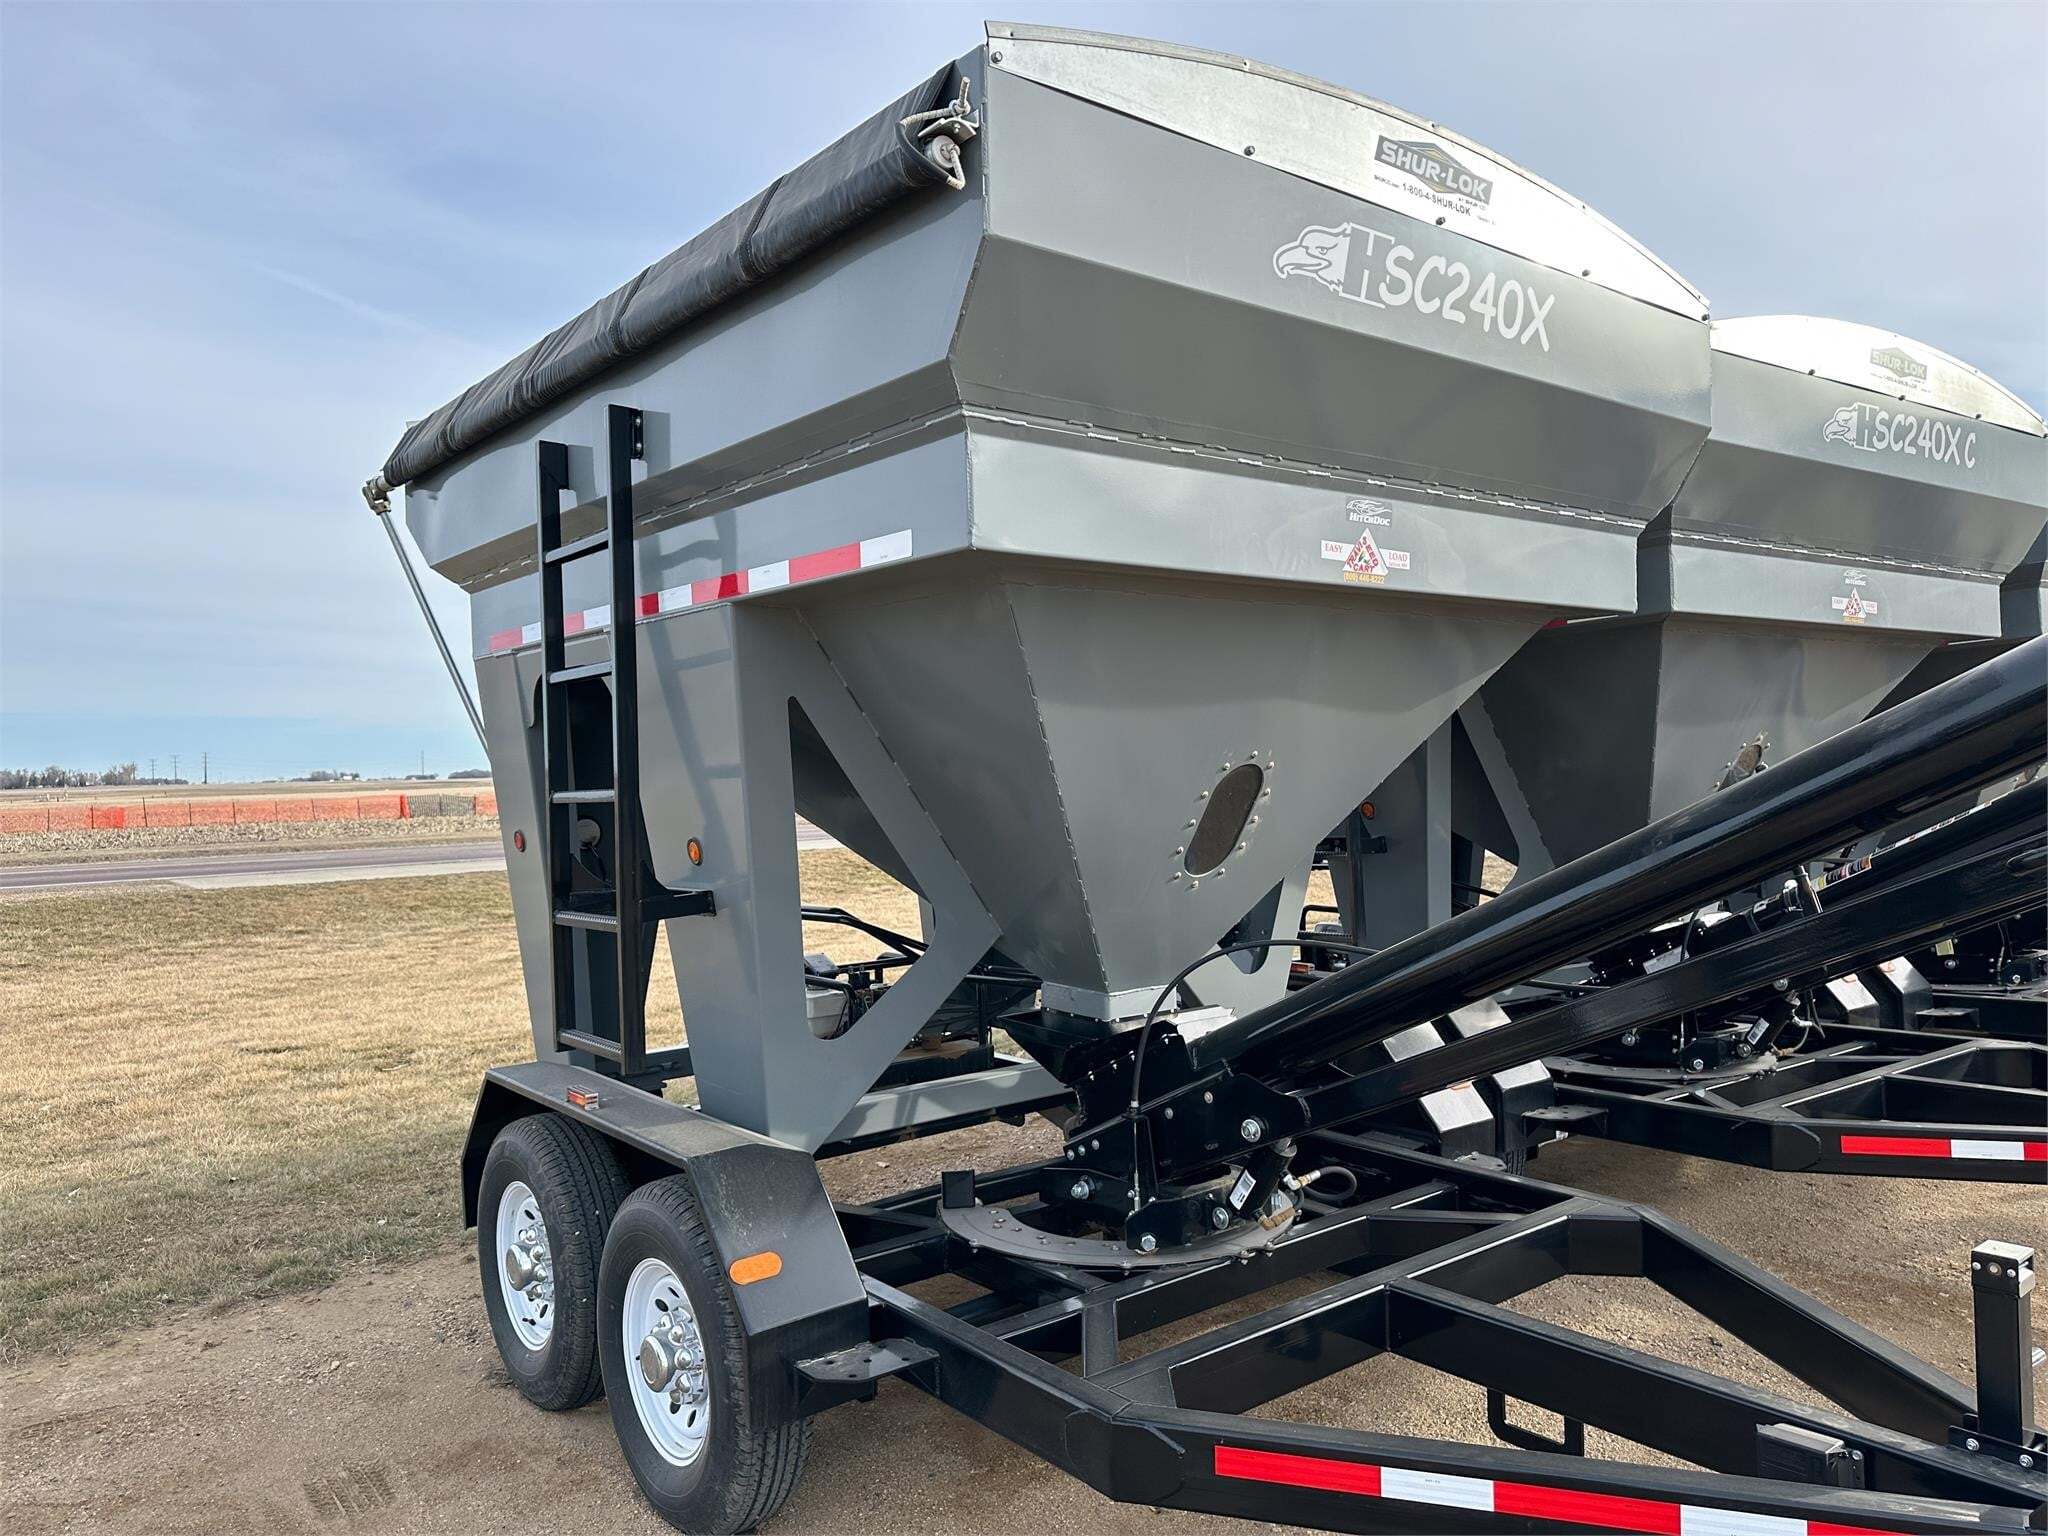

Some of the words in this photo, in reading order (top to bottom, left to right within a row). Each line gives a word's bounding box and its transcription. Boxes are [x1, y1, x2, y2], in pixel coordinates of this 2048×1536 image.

[1325, 543, 1344, 553] EASY
[1388, 551, 1408, 562] LOAD
[1353, 563, 1377, 573] CART
